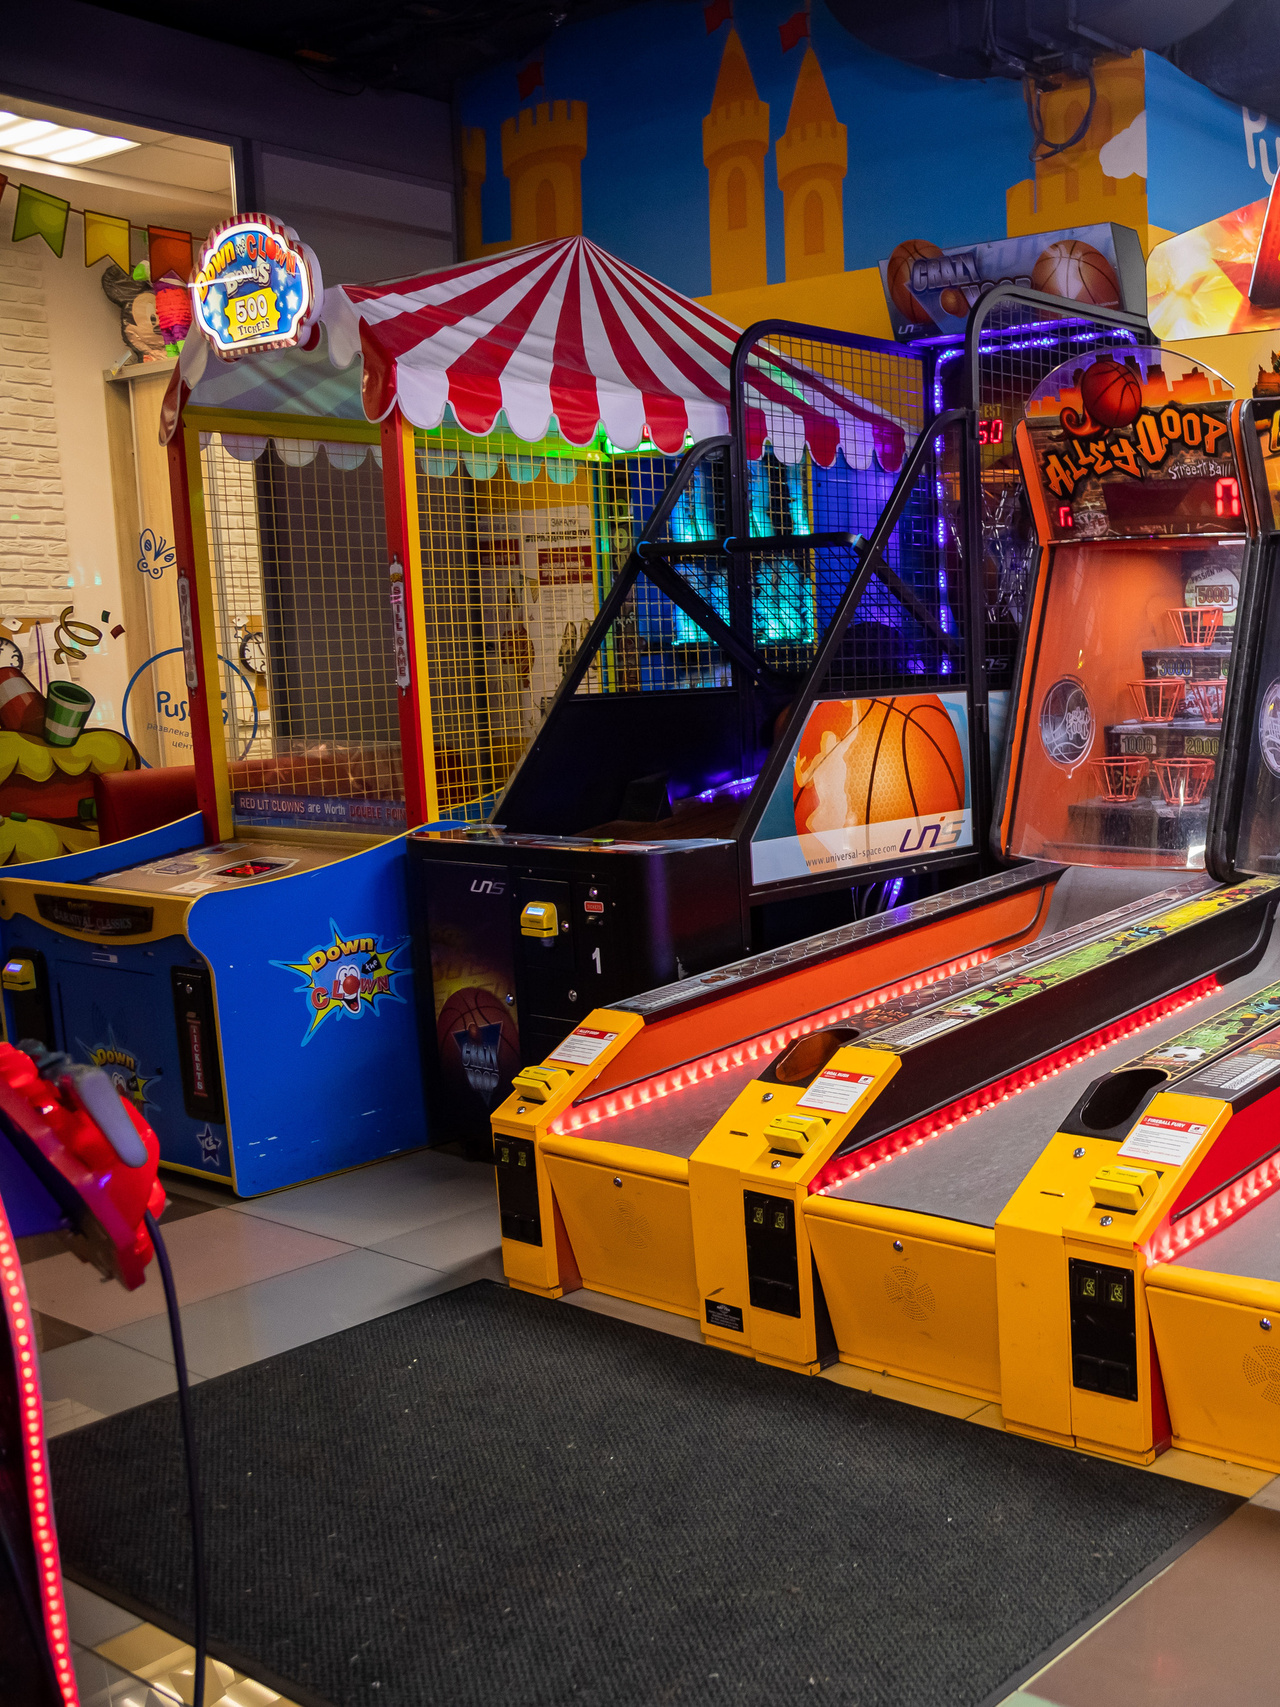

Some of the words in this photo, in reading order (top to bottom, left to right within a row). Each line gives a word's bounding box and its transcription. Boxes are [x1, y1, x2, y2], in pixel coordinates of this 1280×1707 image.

[246, 233, 296, 277] CLOWN
[194, 241, 237, 304] Down
[224, 262, 272, 298] BONUS
[911, 252, 982, 292] CRAZY
[235, 294, 268, 323] 500
[237, 317, 271, 336] TICKETS
[1198, 586, 1230, 604] 5000
[396, 636, 407, 677] GAME
[1159, 659, 1191, 676] 3000
[147, 722, 192, 738] развлека
[172, 740, 192, 750] цент
[1122, 735, 1154, 753] 1000
[1186, 736, 1219, 755] 2000
[240, 797, 256, 809] RED
[257, 799, 270, 811] LIT
[271, 800, 305, 814] CLOWNS
[307, 803, 321, 815] are
[324, 803, 346, 816] Worth
[350, 805, 382, 819] DOUBLE
[806, 844, 897, 868] www.universal-space.com
[308, 938, 375, 972] Down
[364, 959, 379, 972] the
[591, 947, 602, 974] 1
[311, 974, 390, 1010] CLOWN
[96, 1048, 136, 1071] Down
[191, 1025, 204, 1090] TICKETS
